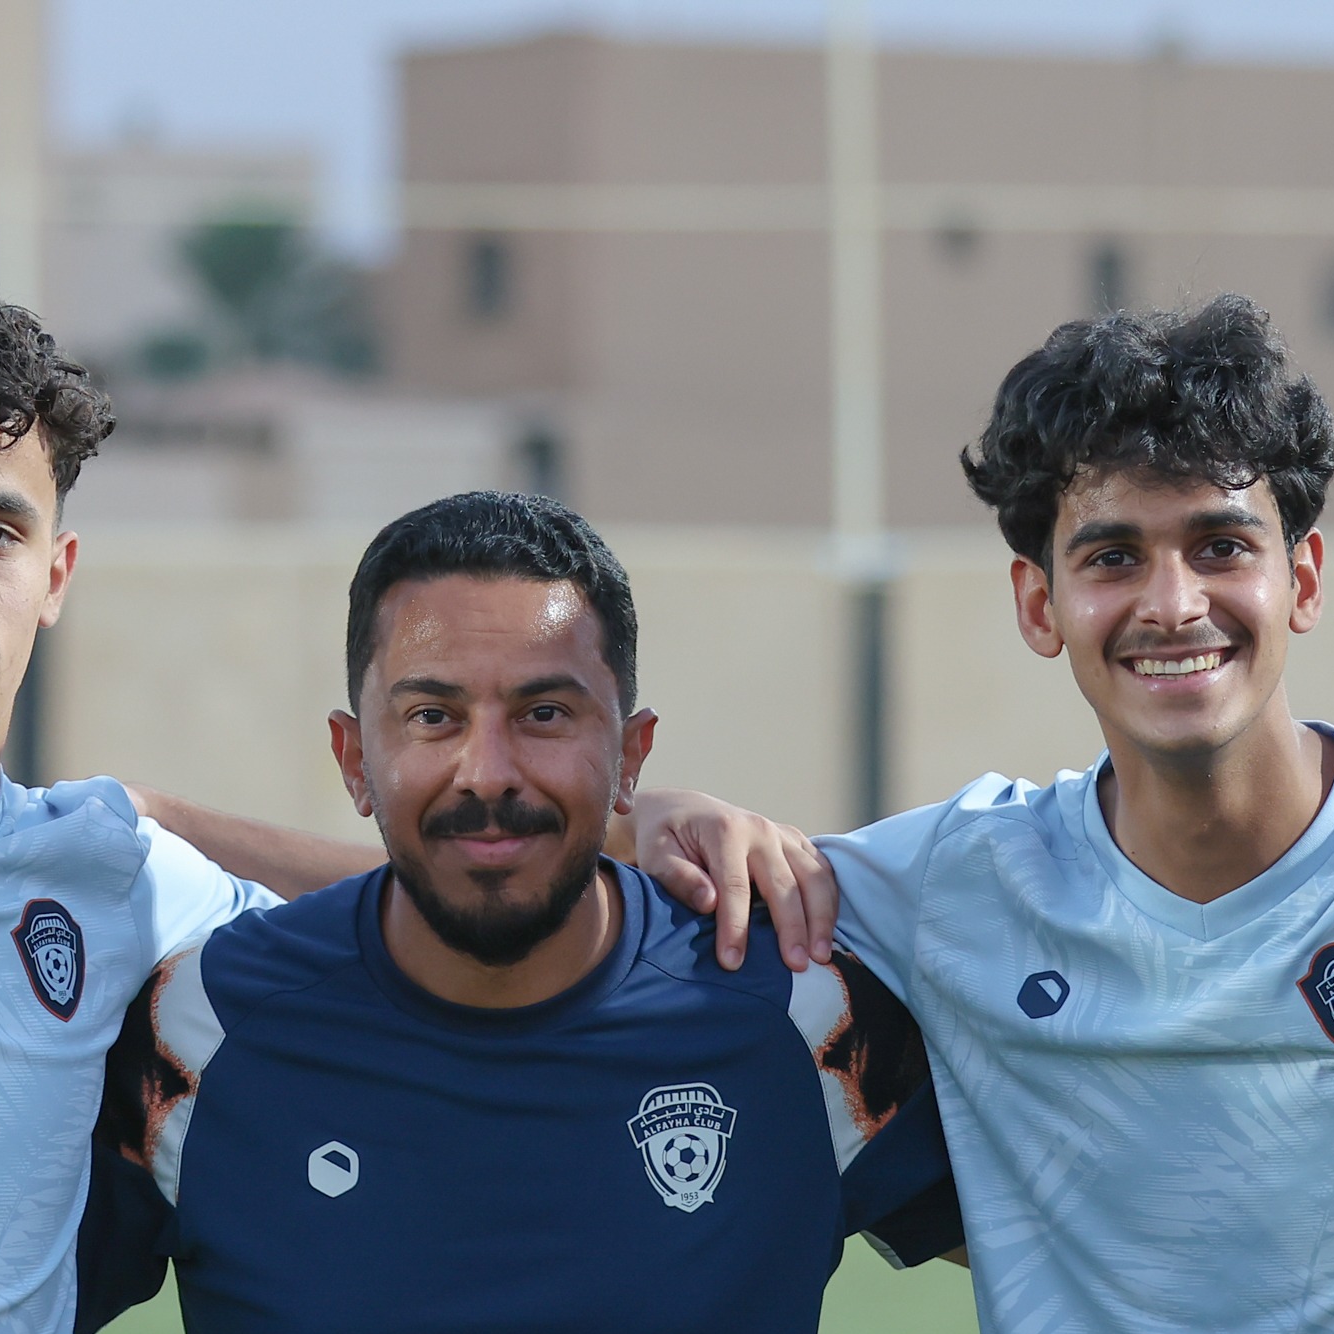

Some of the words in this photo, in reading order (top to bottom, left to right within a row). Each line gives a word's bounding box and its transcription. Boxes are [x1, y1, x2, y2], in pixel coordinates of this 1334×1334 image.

[56, 936, 71, 948] CLUB
[640, 1103, 692, 1128] الفيحاء
[694, 1105, 726, 1120] نادي
[643, 1117, 690, 1138] ALFAYHA
[693, 1117, 722, 1131] CLUB
[680, 1191, 699, 1202] 1953
